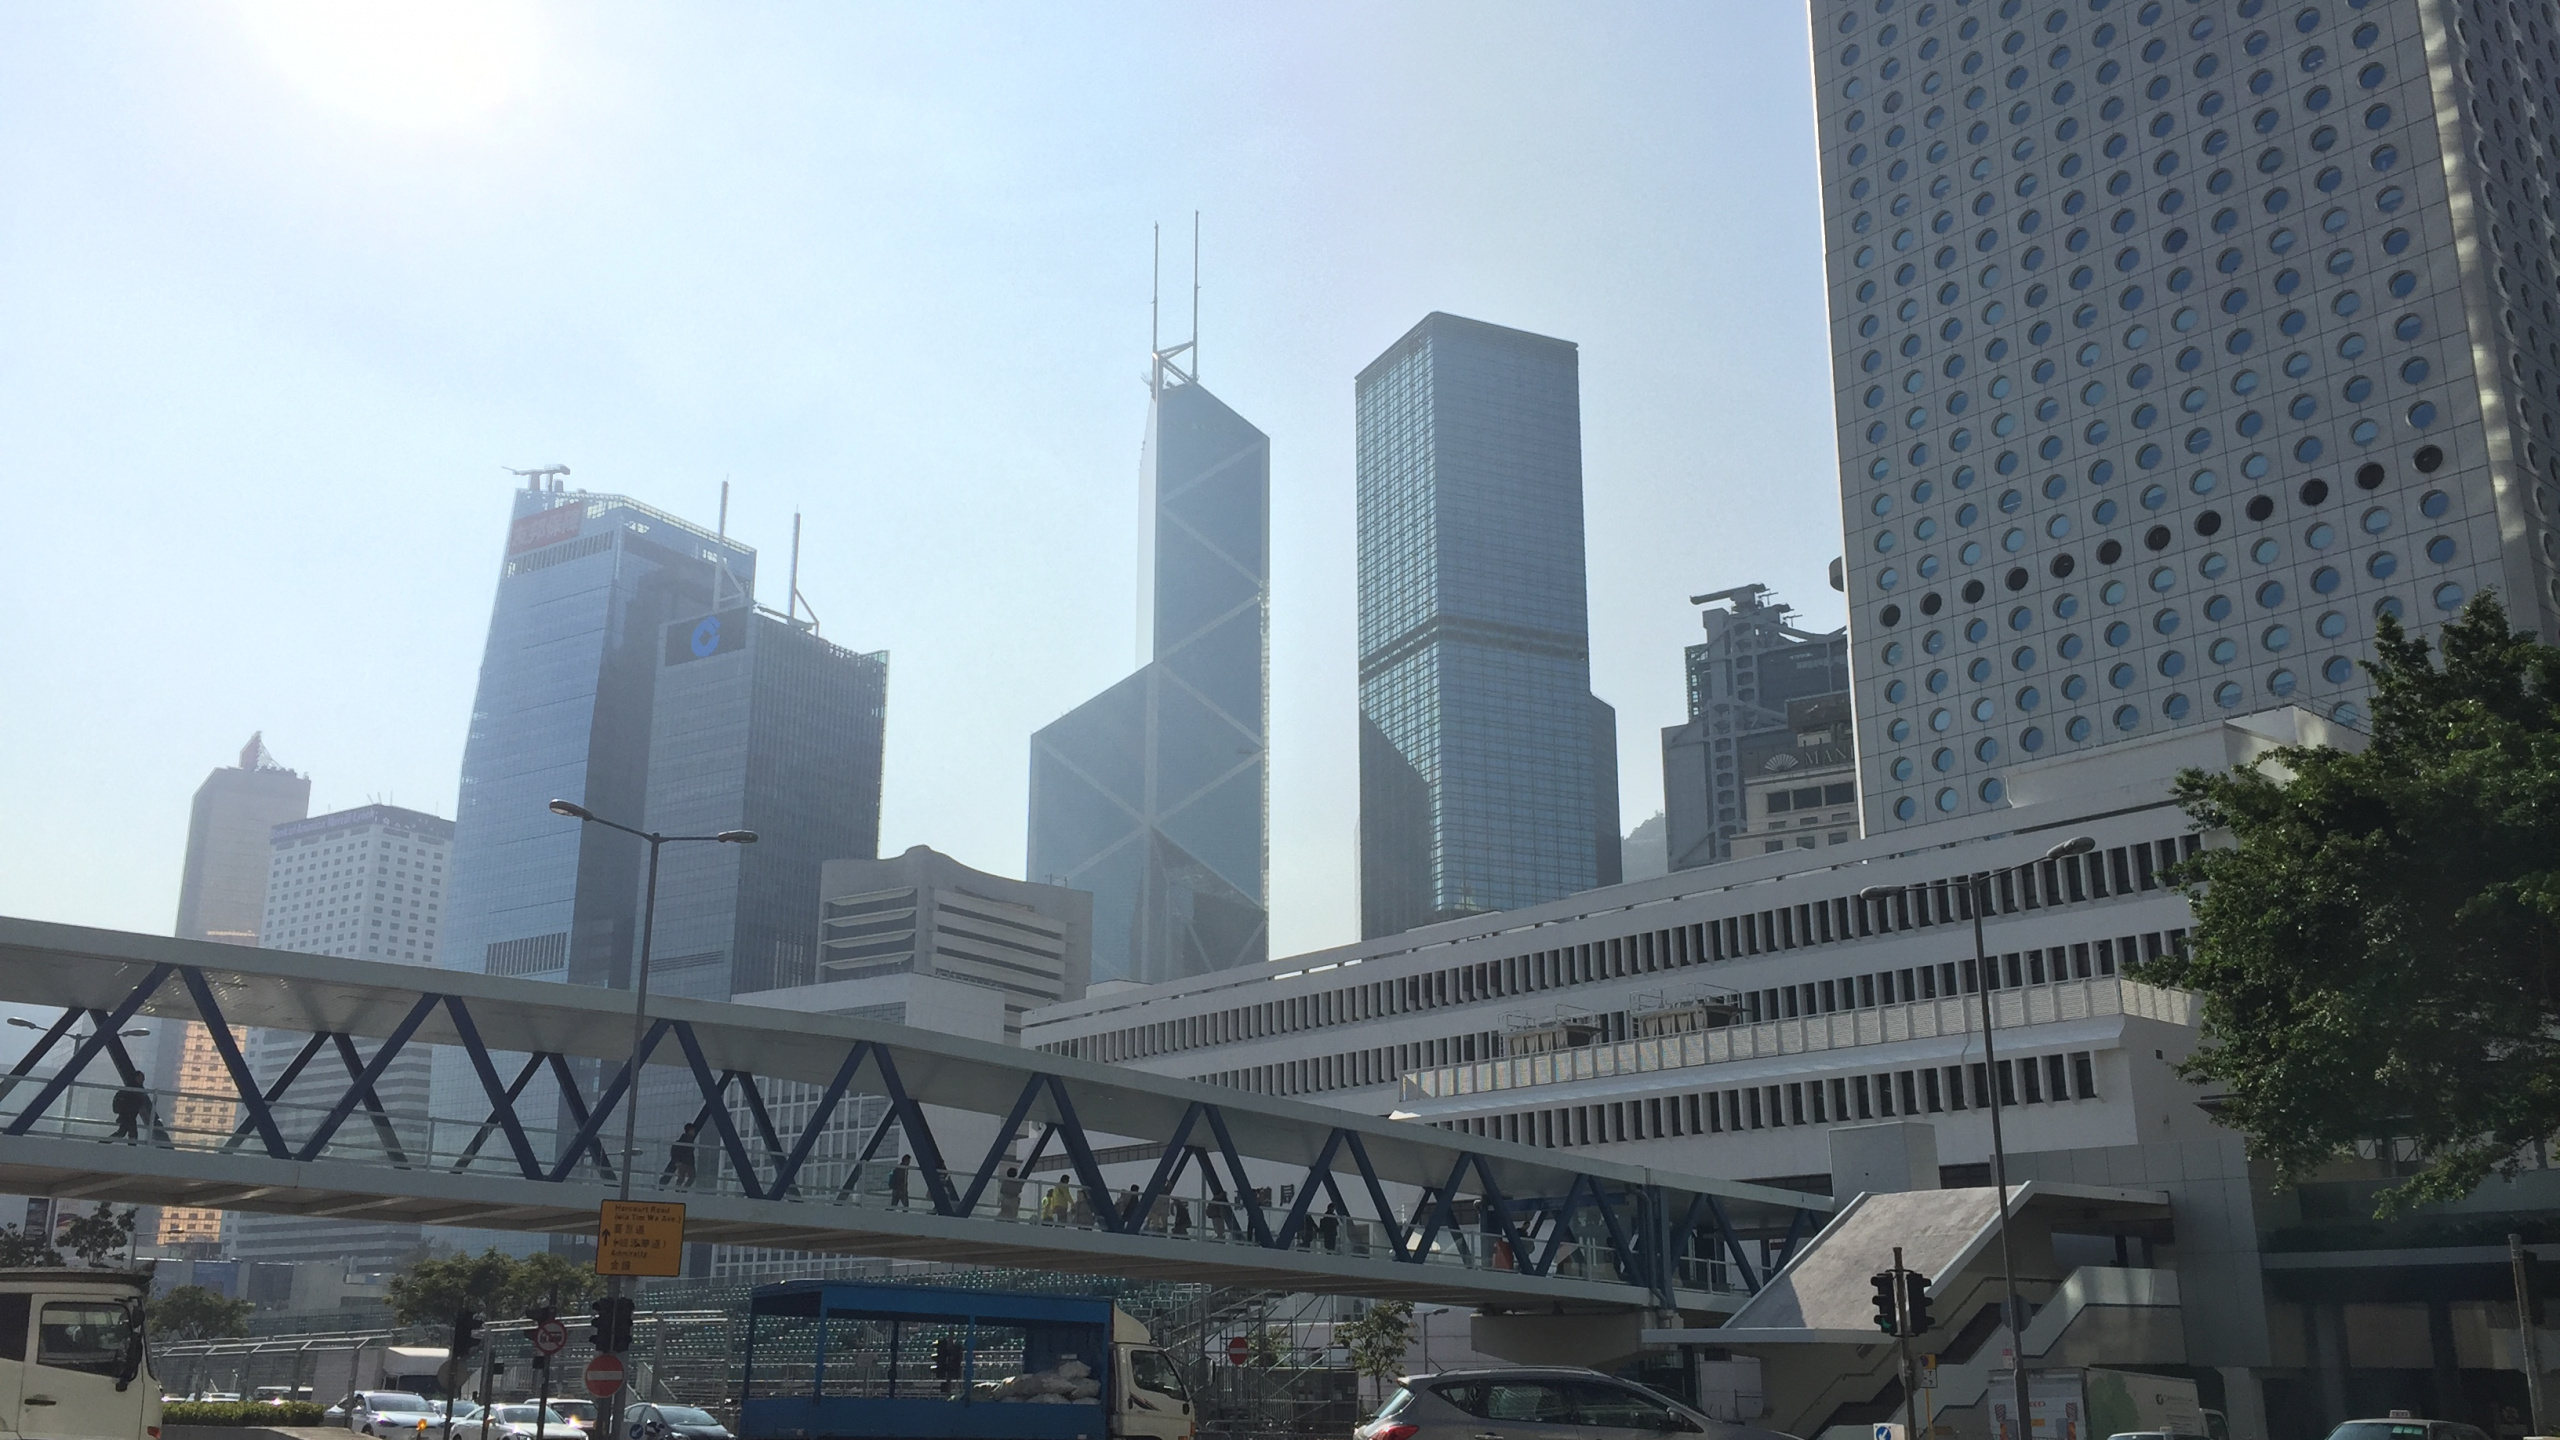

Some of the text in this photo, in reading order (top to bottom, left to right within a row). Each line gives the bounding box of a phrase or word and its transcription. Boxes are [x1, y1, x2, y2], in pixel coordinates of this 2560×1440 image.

[615, 1204, 670, 1214] Harcourt Road
[611, 1249, 648, 1259] Admiralty
